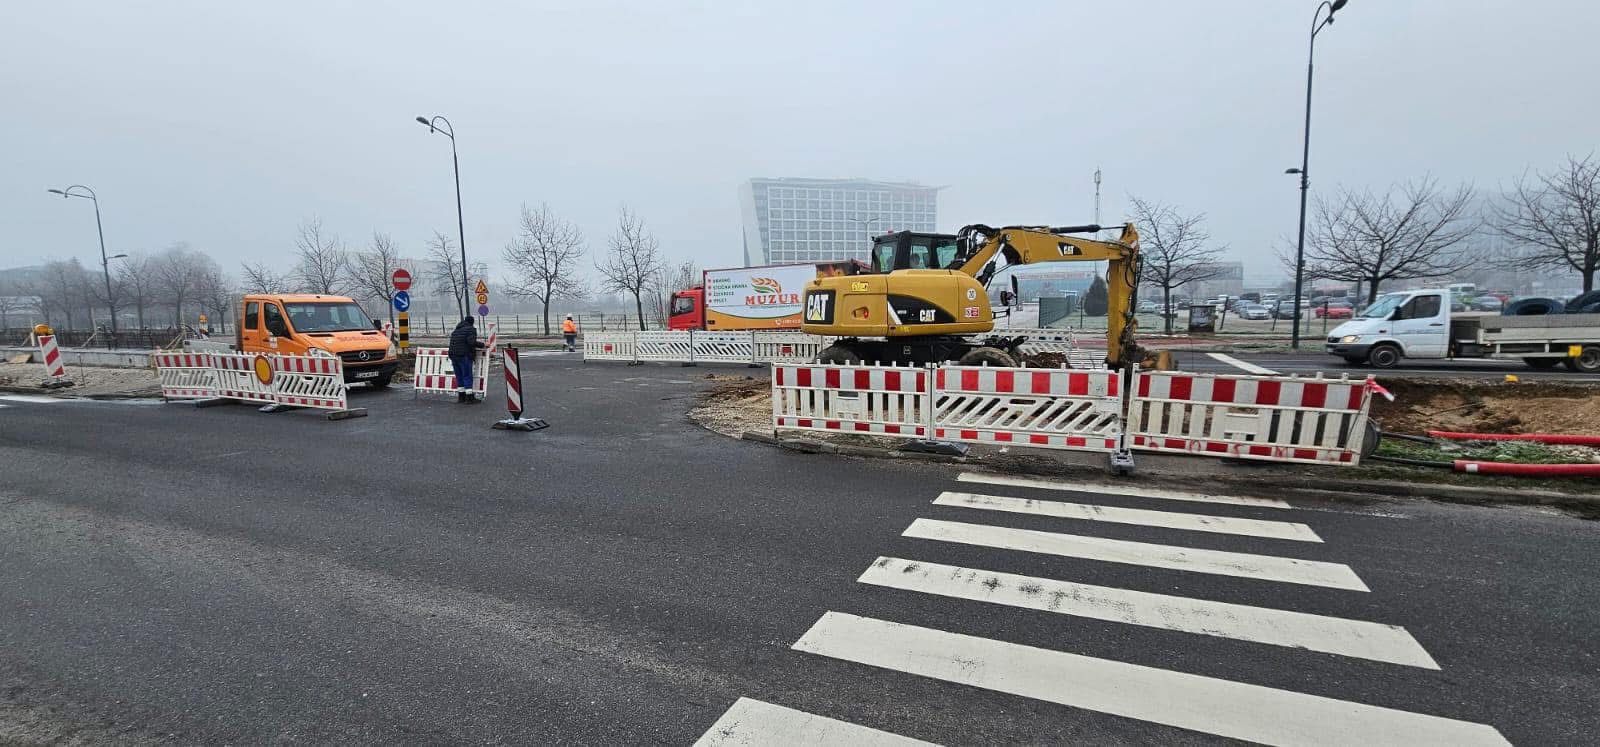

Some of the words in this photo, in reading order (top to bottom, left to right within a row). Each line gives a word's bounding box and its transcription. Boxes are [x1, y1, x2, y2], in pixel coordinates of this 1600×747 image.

[745, 293, 800, 306] MUZUR
[806, 294, 829, 320] CAT
[919, 309, 937, 322] CAT
